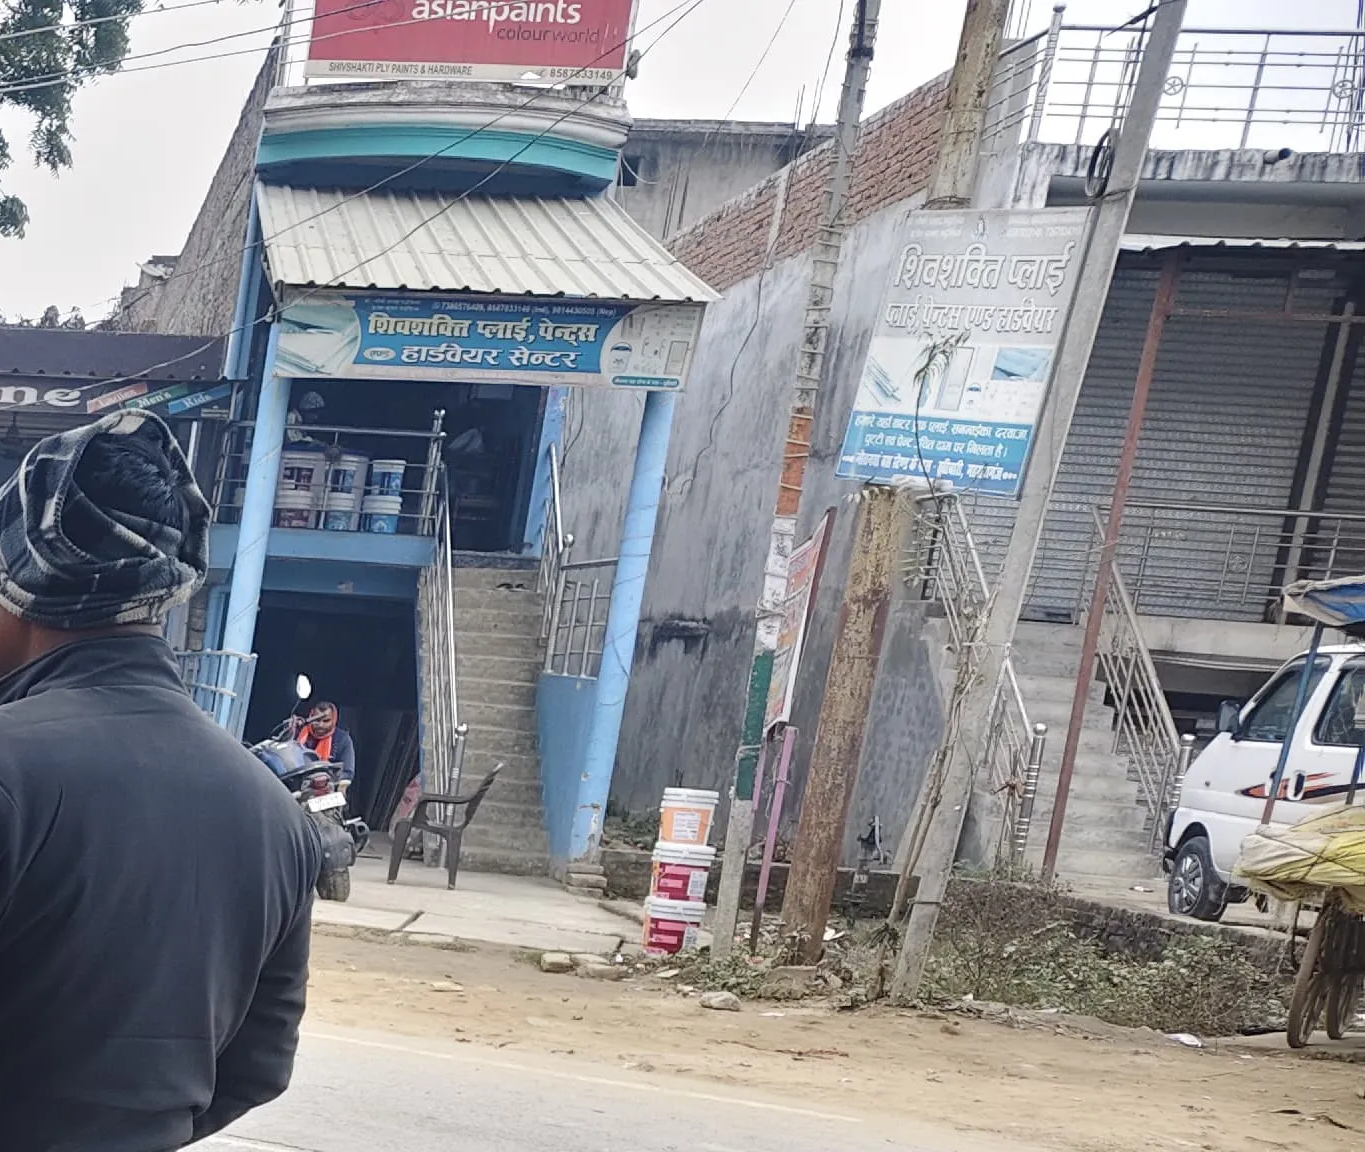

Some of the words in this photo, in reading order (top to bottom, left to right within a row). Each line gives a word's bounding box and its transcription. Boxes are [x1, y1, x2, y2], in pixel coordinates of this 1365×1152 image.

[329, 62, 374, 73] SHIVSHAKTI
[375, 63, 389, 74] PLY
[391, 63, 419, 74] PAINTS
[427, 64, 473, 76] HARDWARE
[894, 242, 1006, 290] शिवशक्ति
[1008, 241, 1076, 297] प्लाई
[368, 313, 471, 338] शिवशक्ति
[401, 343, 504, 366] हार्डवेयर
[508, 346, 581, 369] सेन्टर
[183, 392, 210, 408] Kids
